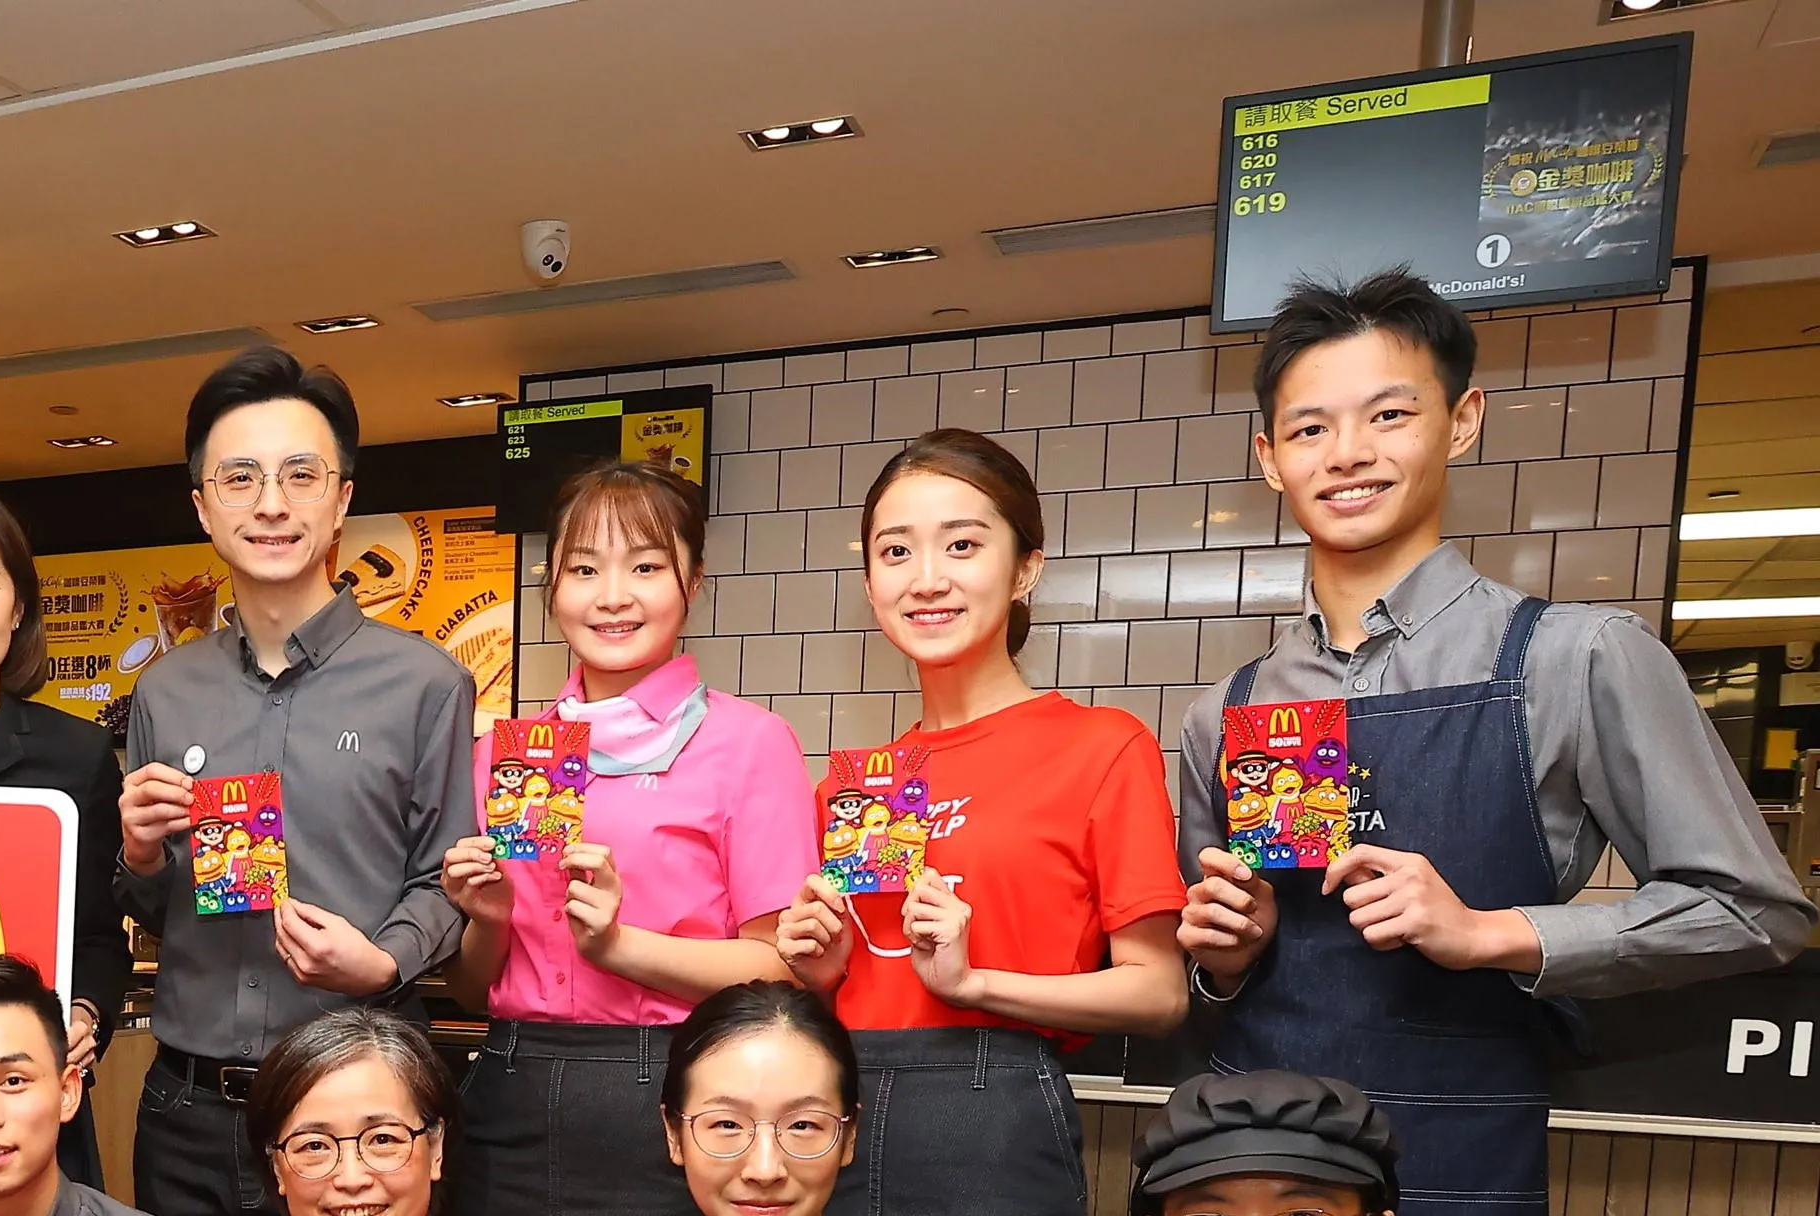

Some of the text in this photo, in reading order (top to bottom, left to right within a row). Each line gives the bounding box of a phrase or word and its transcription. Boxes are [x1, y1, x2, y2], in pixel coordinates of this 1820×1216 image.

[1244, 88, 1408, 128] 請取餐 Served
[1241, 133, 1279, 151] 616
[1240, 153, 1277, 171] 620
[1239, 172, 1276, 190] 617
[1538, 159, 1635, 192] 金獎咖啡
[1233, 192, 1287, 216] 619
[1486, 239, 1500, 264] 1
[547, 405, 585, 418] Served
[507, 436, 525, 445] 623
[508, 426, 525, 435] 621
[505, 447, 531, 459] 625
[399, 516, 433, 621] CHEESECAKE
[41, 592, 105, 615] 金獎咖啡
[435, 589, 499, 641] CIABATTA
[85, 683, 112, 701] $192
[1726, 1018, 1814, 1078] PI
